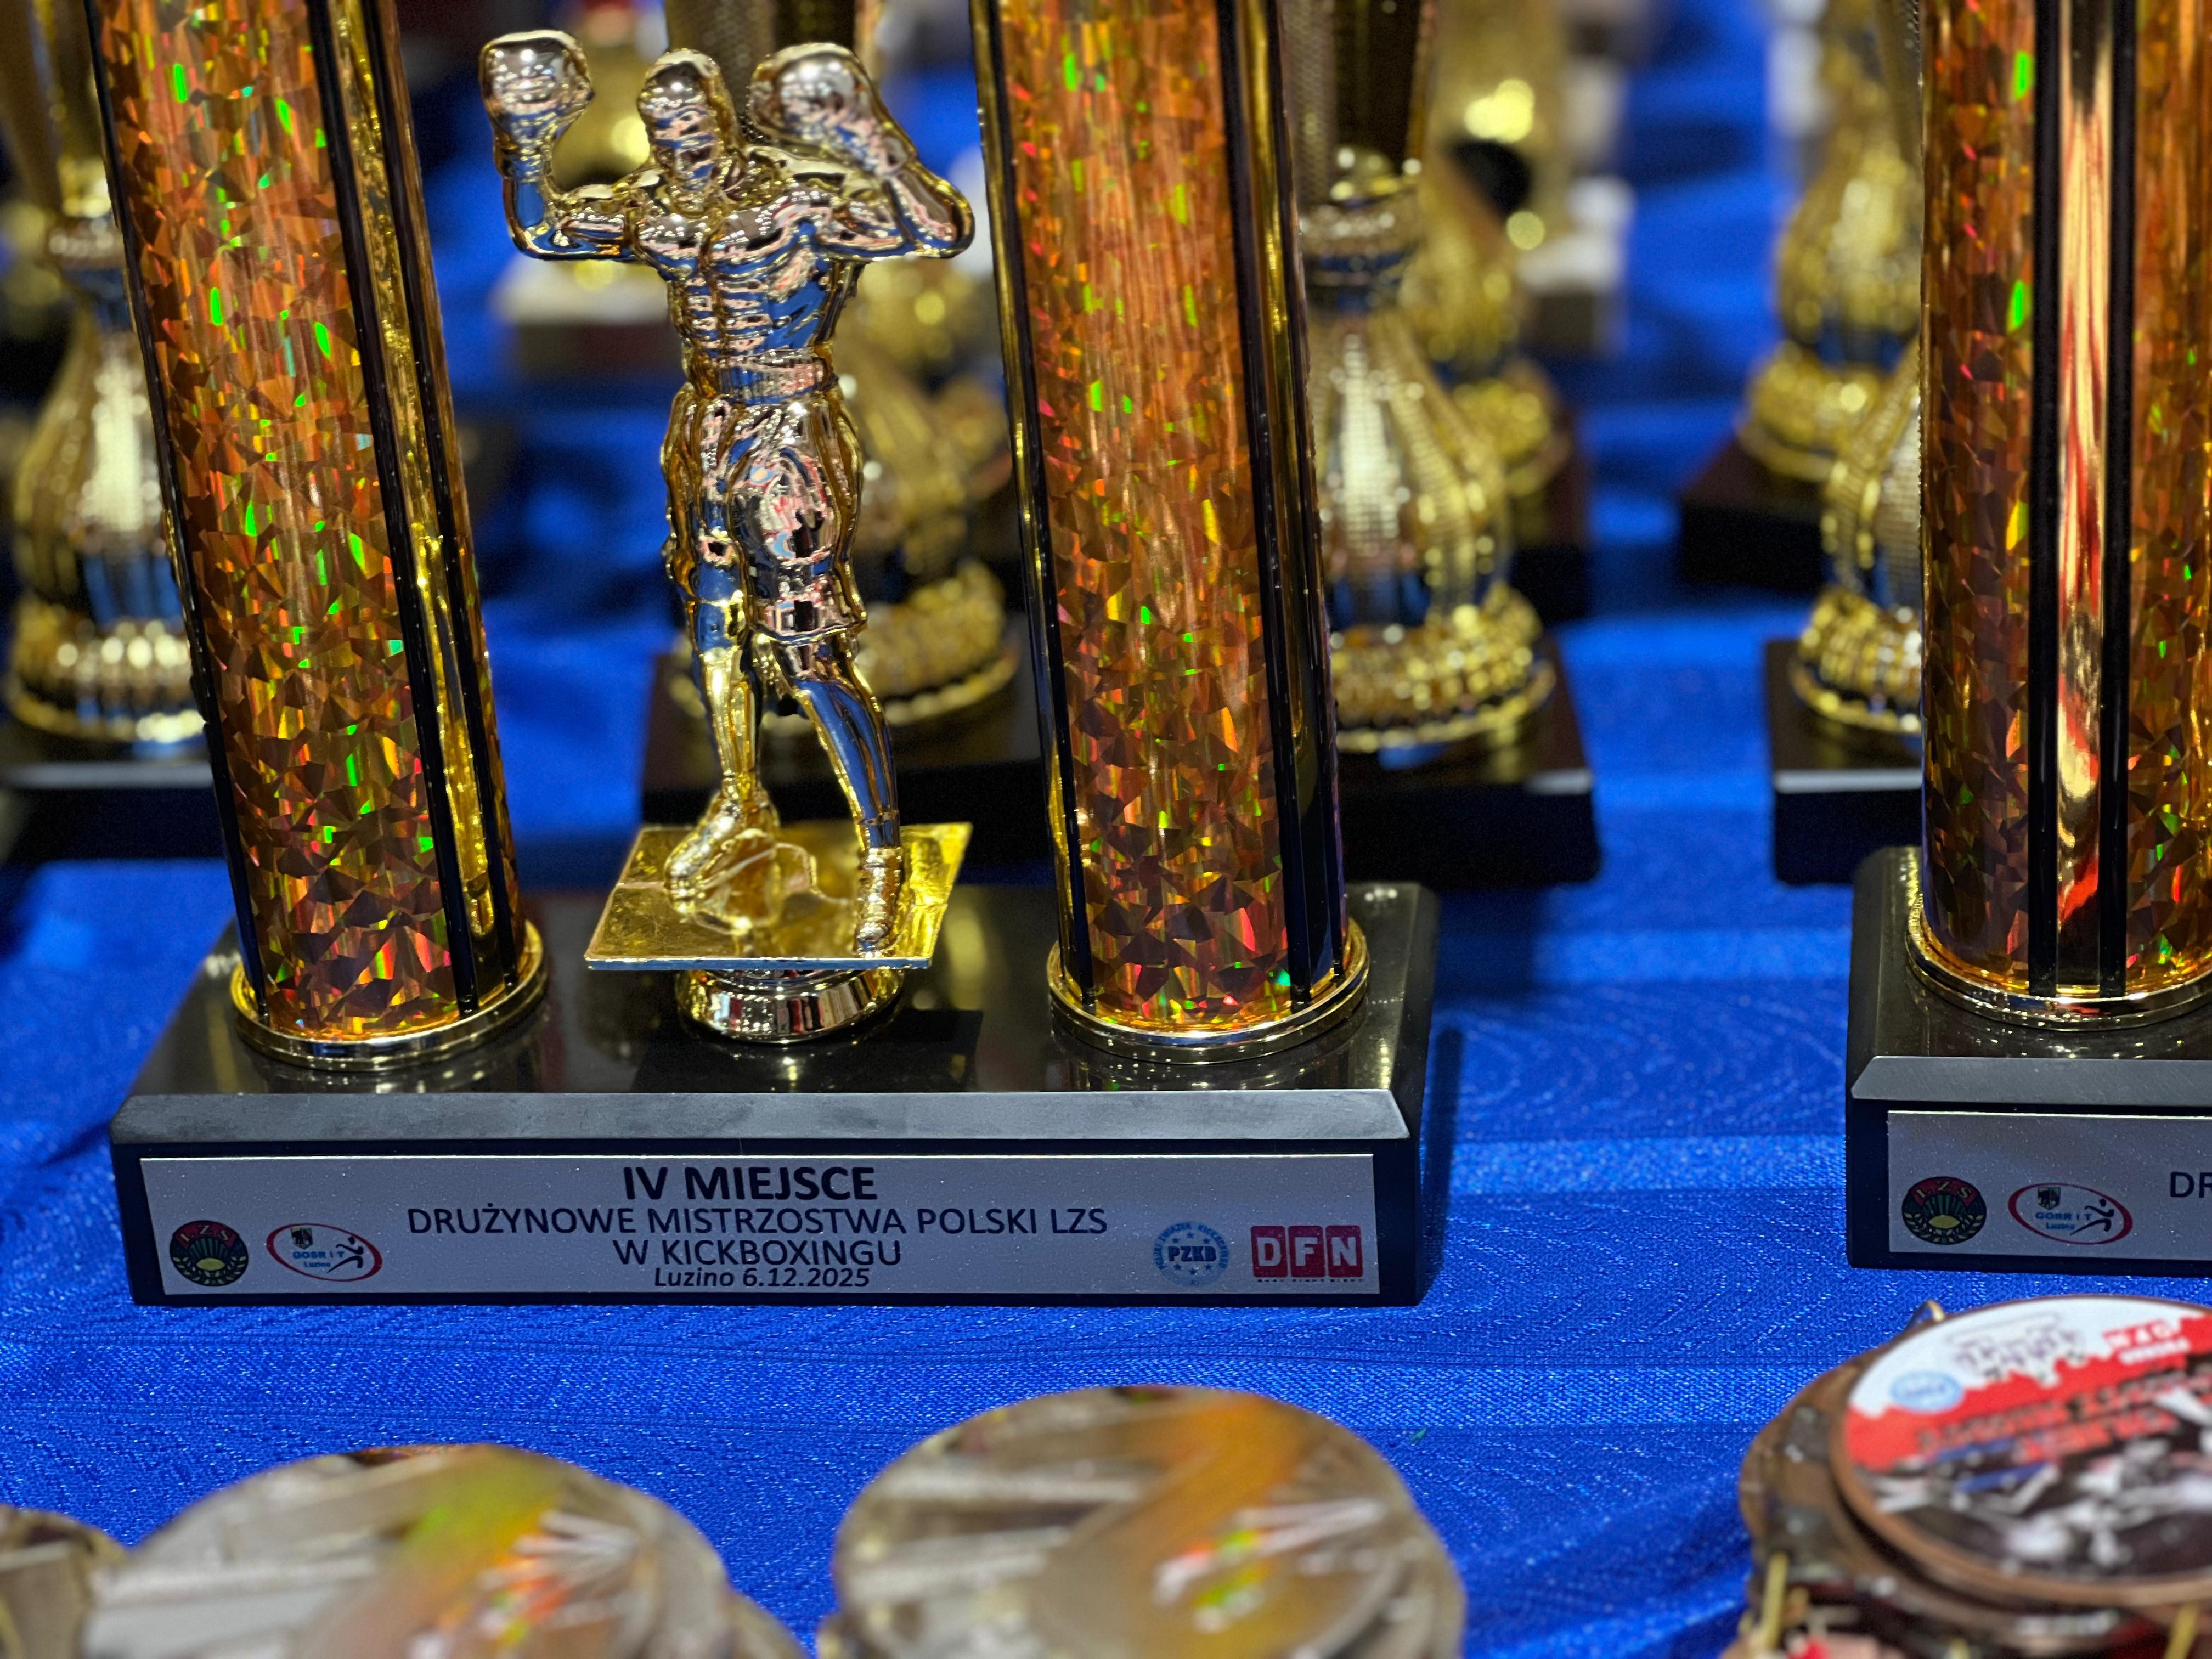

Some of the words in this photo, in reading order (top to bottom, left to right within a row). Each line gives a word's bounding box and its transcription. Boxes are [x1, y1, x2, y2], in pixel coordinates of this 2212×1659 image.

[623, 1167, 668, 1200] IV
[684, 1167, 878, 1200] MIEJSCE
[408, 1203, 636, 1234] DRUŻYNOWE
[647, 1208, 907, 1234] MISTRZOSTWA
[917, 1208, 1037, 1234] POLSKI
[1051, 1208, 1108, 1234] LZS
[612, 1240, 648, 1265] W
[662, 1240, 901, 1266] KICKBOXINGU
[1168, 1246, 1217, 1262] PZKB
[1257, 1236, 1358, 1267] DFN
[654, 1267, 734, 1286] Luzino
[743, 1267, 870, 1287] 6.12.2025
